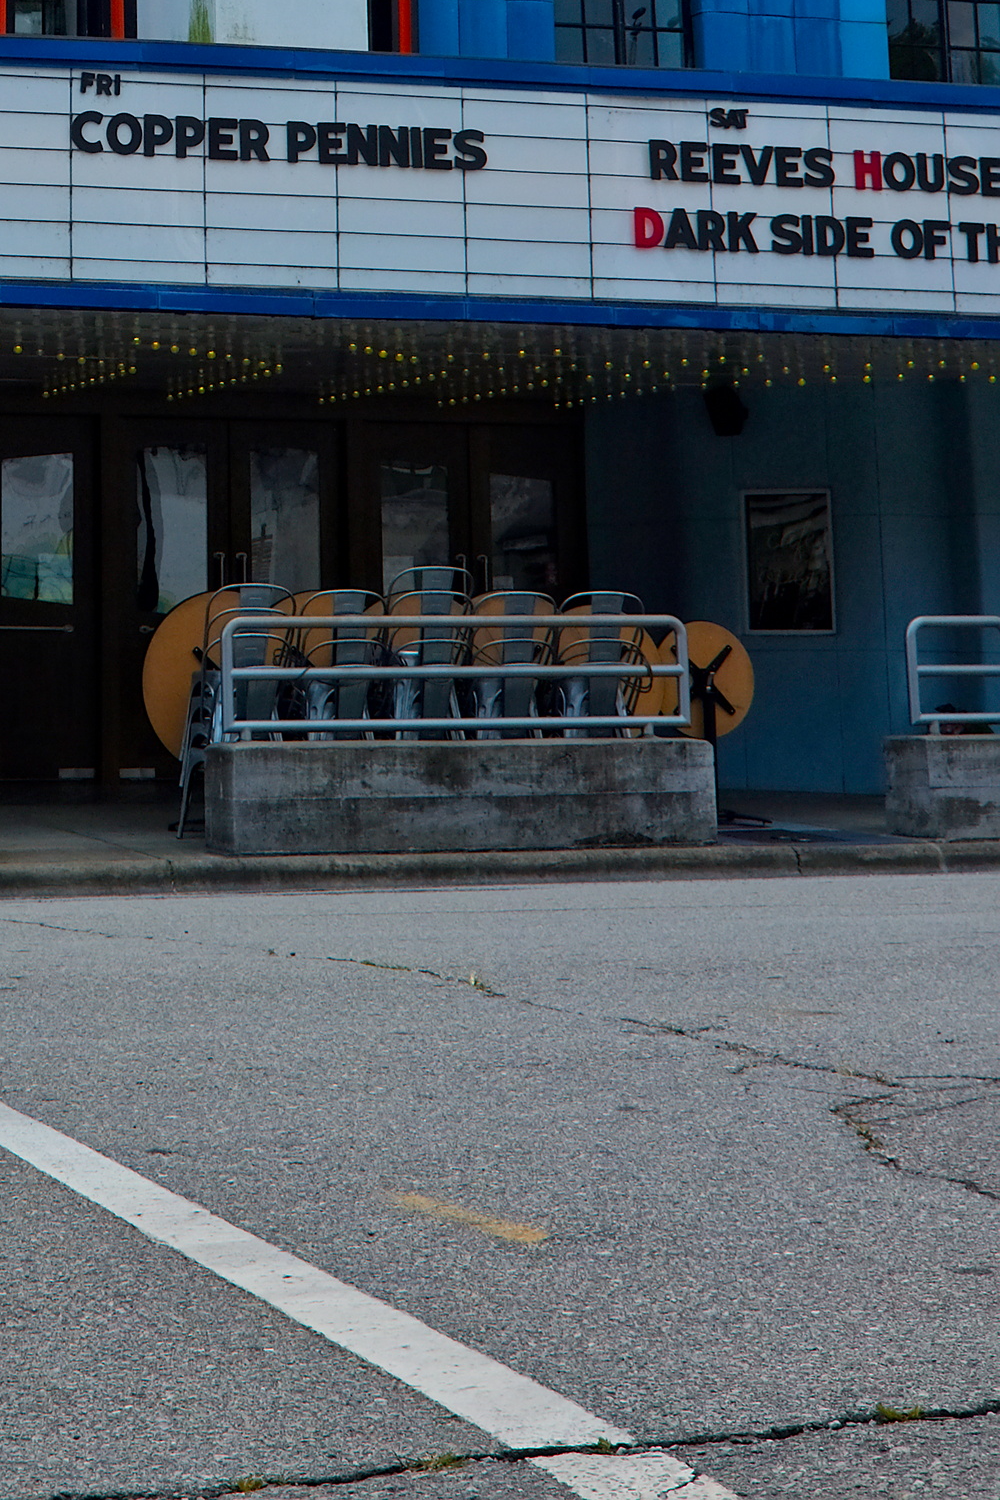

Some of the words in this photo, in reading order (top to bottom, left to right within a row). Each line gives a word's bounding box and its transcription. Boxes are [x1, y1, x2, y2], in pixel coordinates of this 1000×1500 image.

[80, 71, 121, 96] FRI
[70, 110, 271, 162] COPPER
[286, 120, 488, 171] PENNIES
[709, 107, 749, 129] SAT
[648, 139, 836, 188] REEVES
[853, 149, 1000, 197] HOUSE
[633, 206, 760, 253] DARK
[769, 214, 875, 258] SIDE
[891, 218, 950, 260] OF
